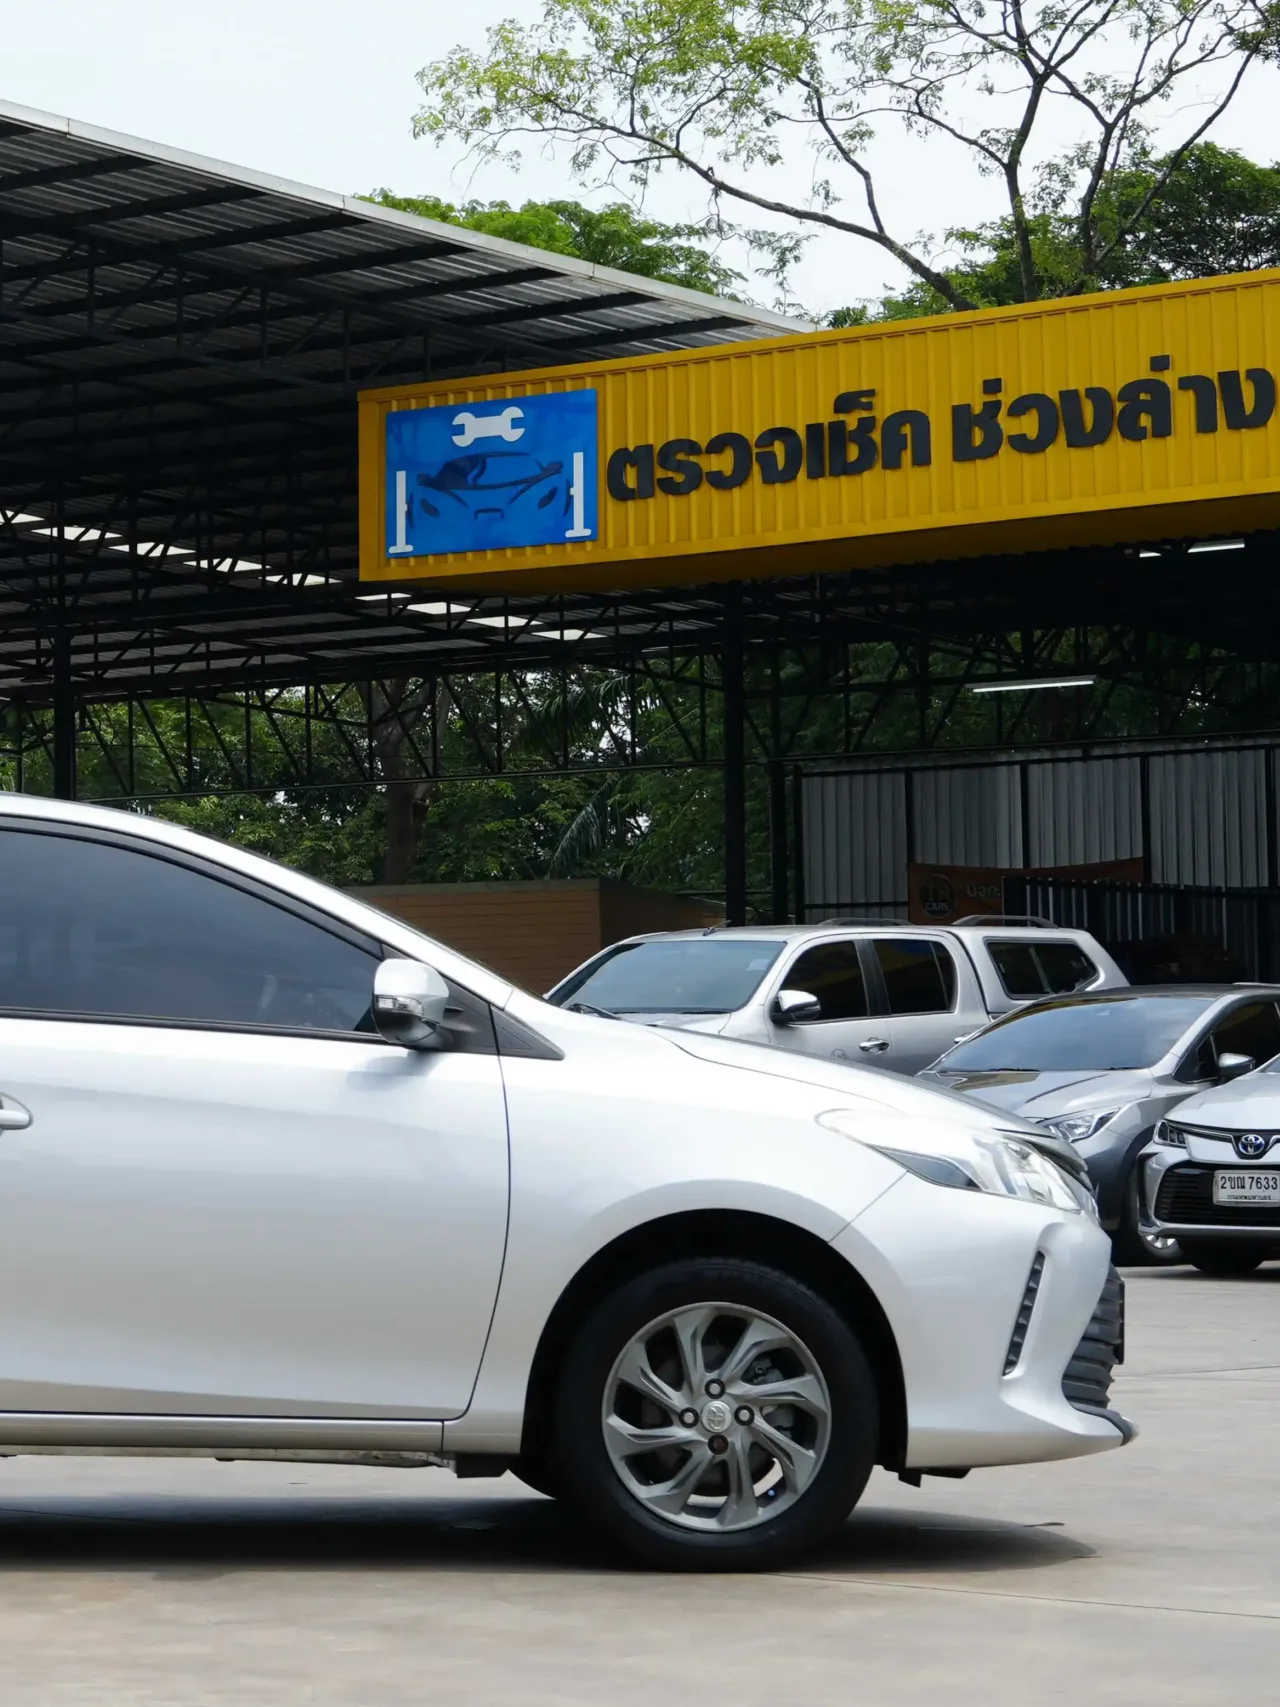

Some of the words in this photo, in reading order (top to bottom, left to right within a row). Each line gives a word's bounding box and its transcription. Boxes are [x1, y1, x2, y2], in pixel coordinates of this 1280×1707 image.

[607, 388, 931, 501] ตรวจเช็ค
[952, 355, 1277, 463] ช่วงล่าง
[925, 902, 948, 911] CARS
[1248, 1176, 1278, 1190] 7633
